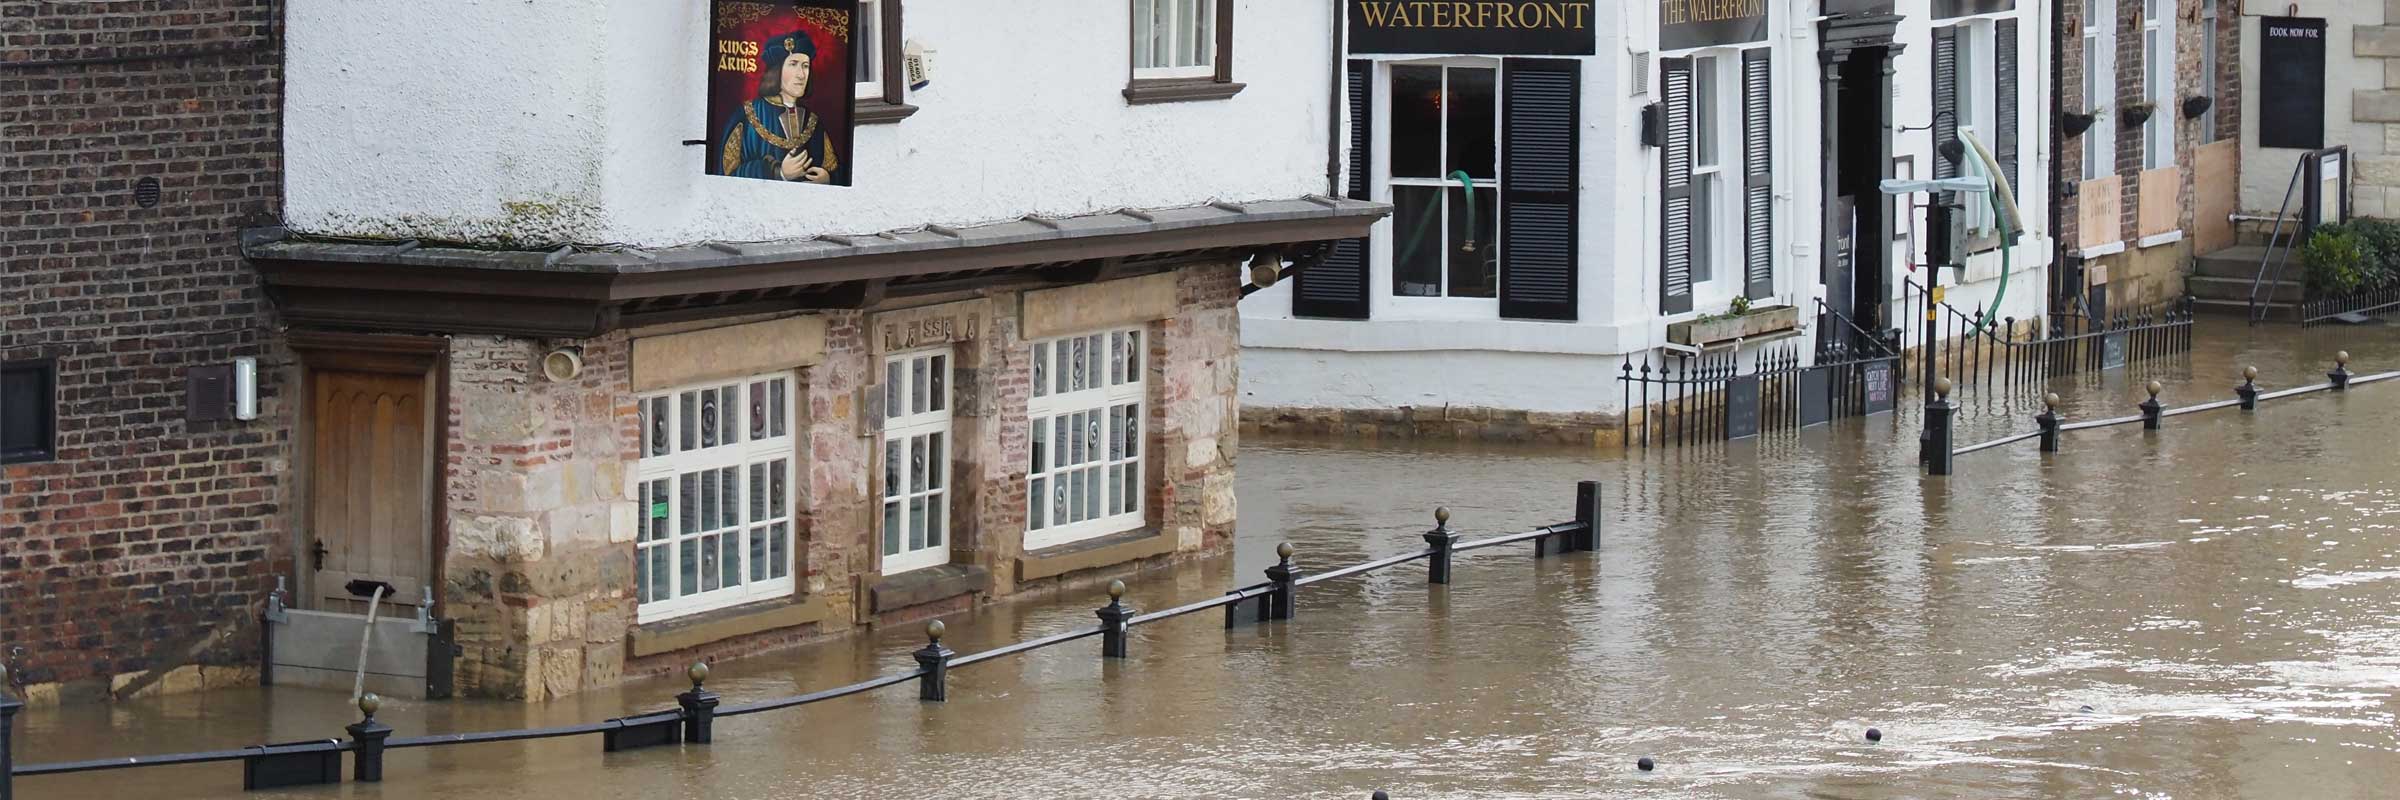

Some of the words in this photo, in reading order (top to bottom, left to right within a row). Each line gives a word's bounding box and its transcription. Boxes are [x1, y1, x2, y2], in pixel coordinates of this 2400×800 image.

[1360, 1, 1589, 29] WATERFRONT
[1662, 0, 1686, 25] THE
[1689, 0, 1765, 22] WATERFRONT
[2269, 26, 2288, 37] BOOK
[2289, 28, 2304, 38] NOW
[2305, 28, 2319, 38] FOR
[719, 39, 759, 57] KINGS
[717, 54, 758, 73] ARMS
